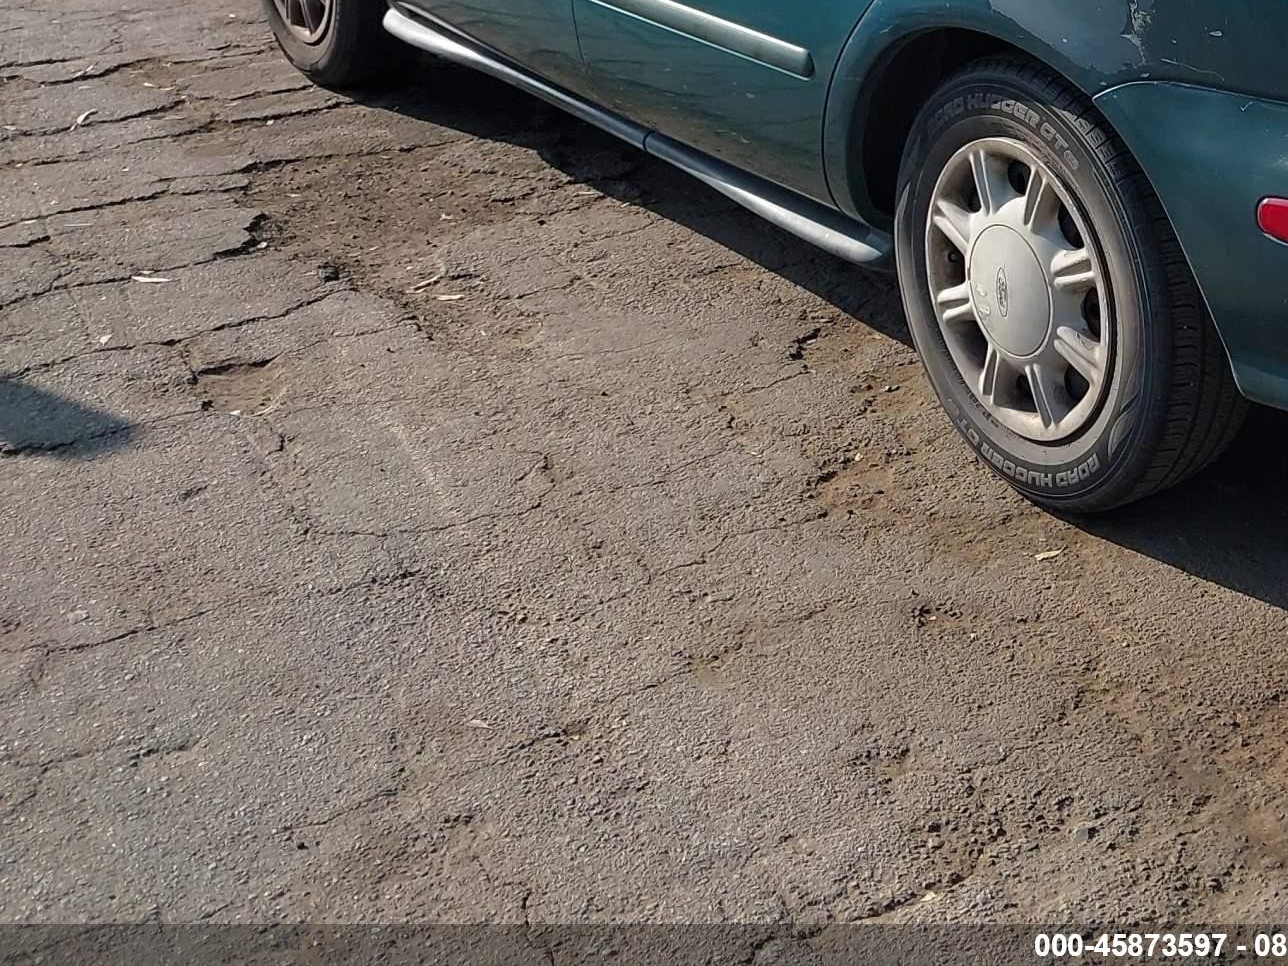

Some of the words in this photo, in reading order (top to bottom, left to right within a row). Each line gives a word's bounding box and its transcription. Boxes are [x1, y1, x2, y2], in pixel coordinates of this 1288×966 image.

[967, 93, 1042, 129] HUGGER
[1039, 121, 1069, 151] GT
[955, 417, 980, 447] GT
[980, 441, 1054, 488] HUGGER
[1055, 452, 1100, 488] ROAD
